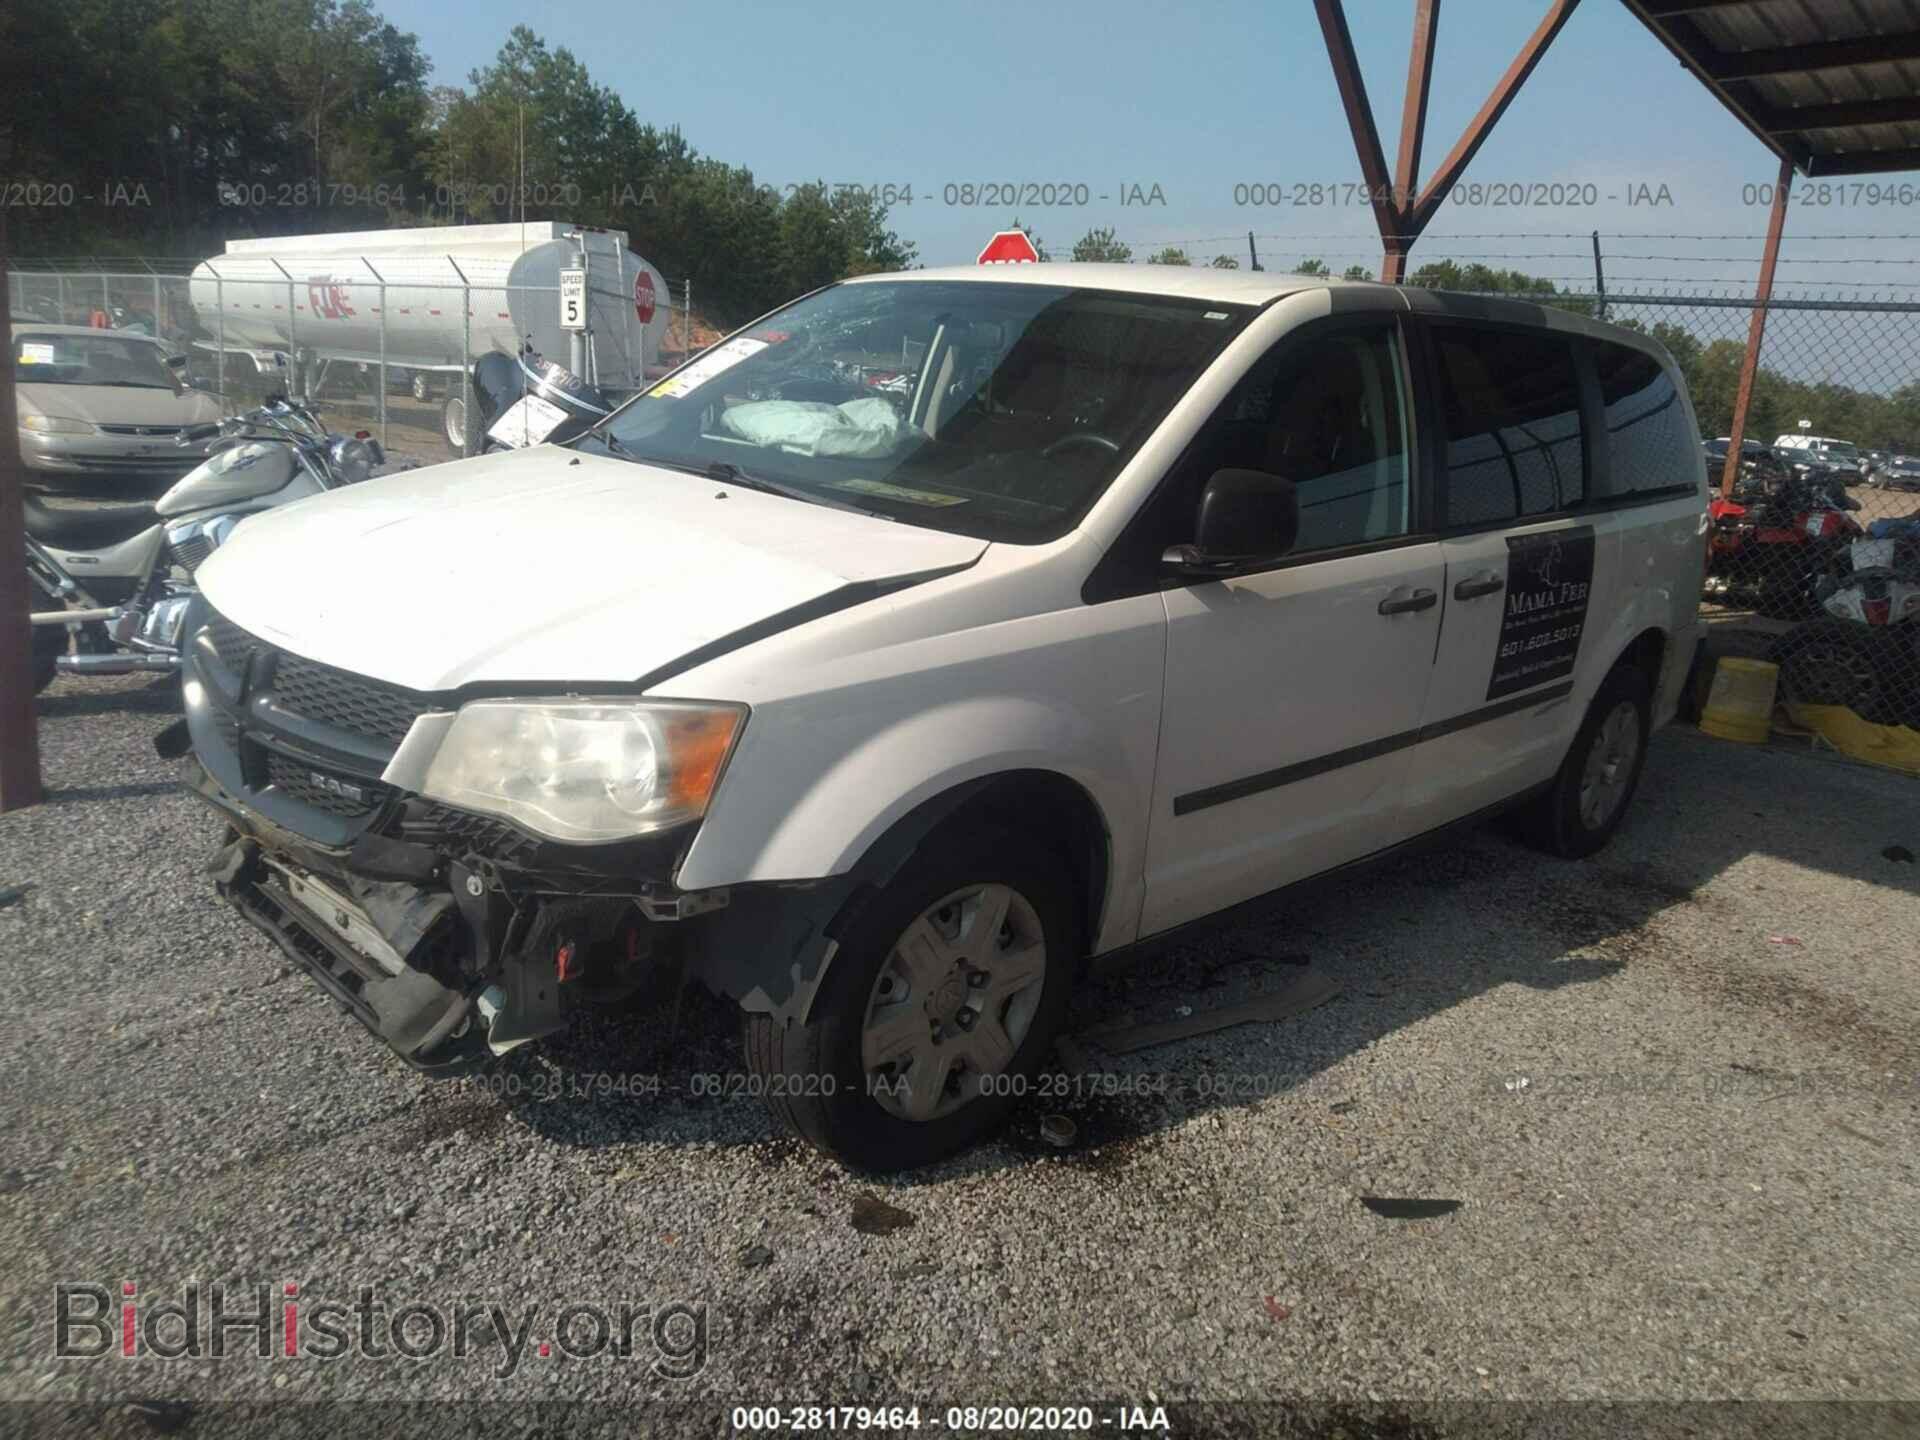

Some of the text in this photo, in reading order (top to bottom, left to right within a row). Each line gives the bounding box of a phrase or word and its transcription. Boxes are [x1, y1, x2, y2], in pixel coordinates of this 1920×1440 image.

[562, 275, 582, 284] SPEED
[563, 288, 580, 297] LIMIT
[635, 286, 655, 307] STOP
[567, 301, 578, 321] 5
[1507, 591, 1555, 616] MAMA
